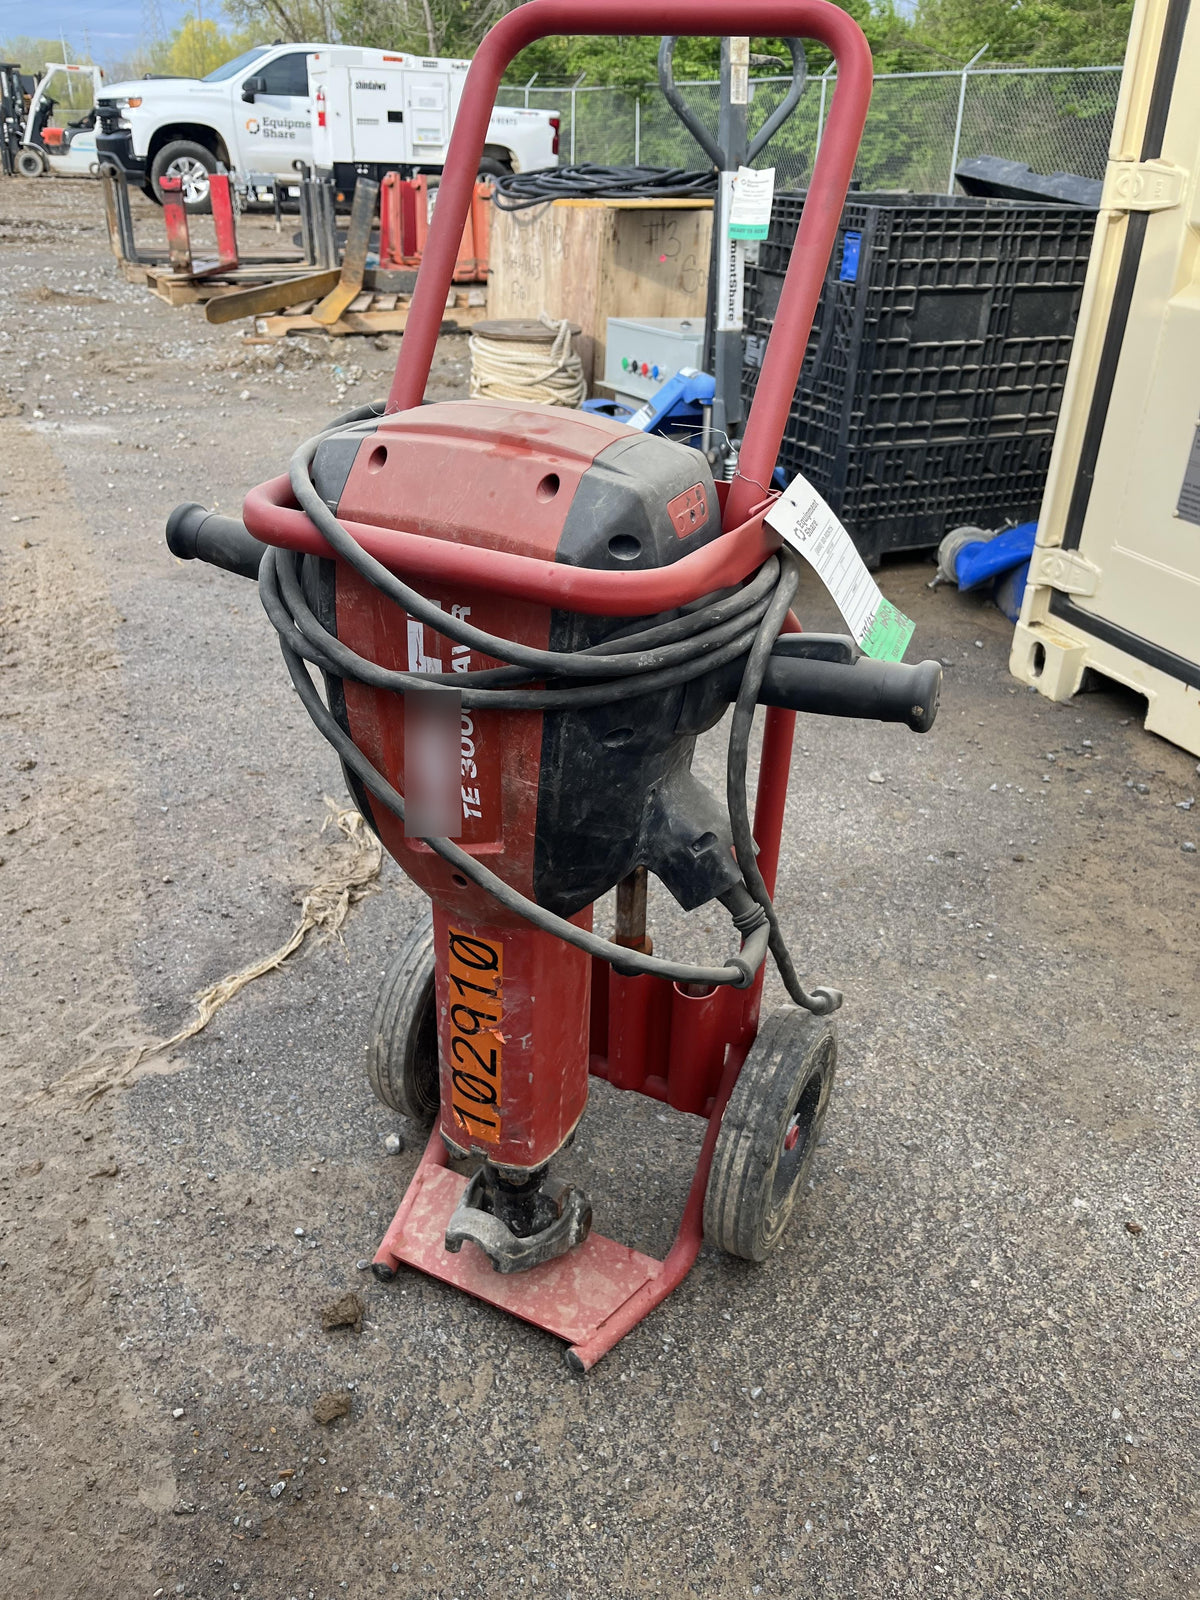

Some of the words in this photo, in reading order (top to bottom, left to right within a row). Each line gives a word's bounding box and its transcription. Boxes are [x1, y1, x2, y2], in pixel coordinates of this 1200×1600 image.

[262, 128, 296, 140] Share
[796, 499, 819, 529] Equipment
[804, 519, 819, 538] Share
[461, 785, 483, 819] TE
[448, 930, 499, 1128] 102910
